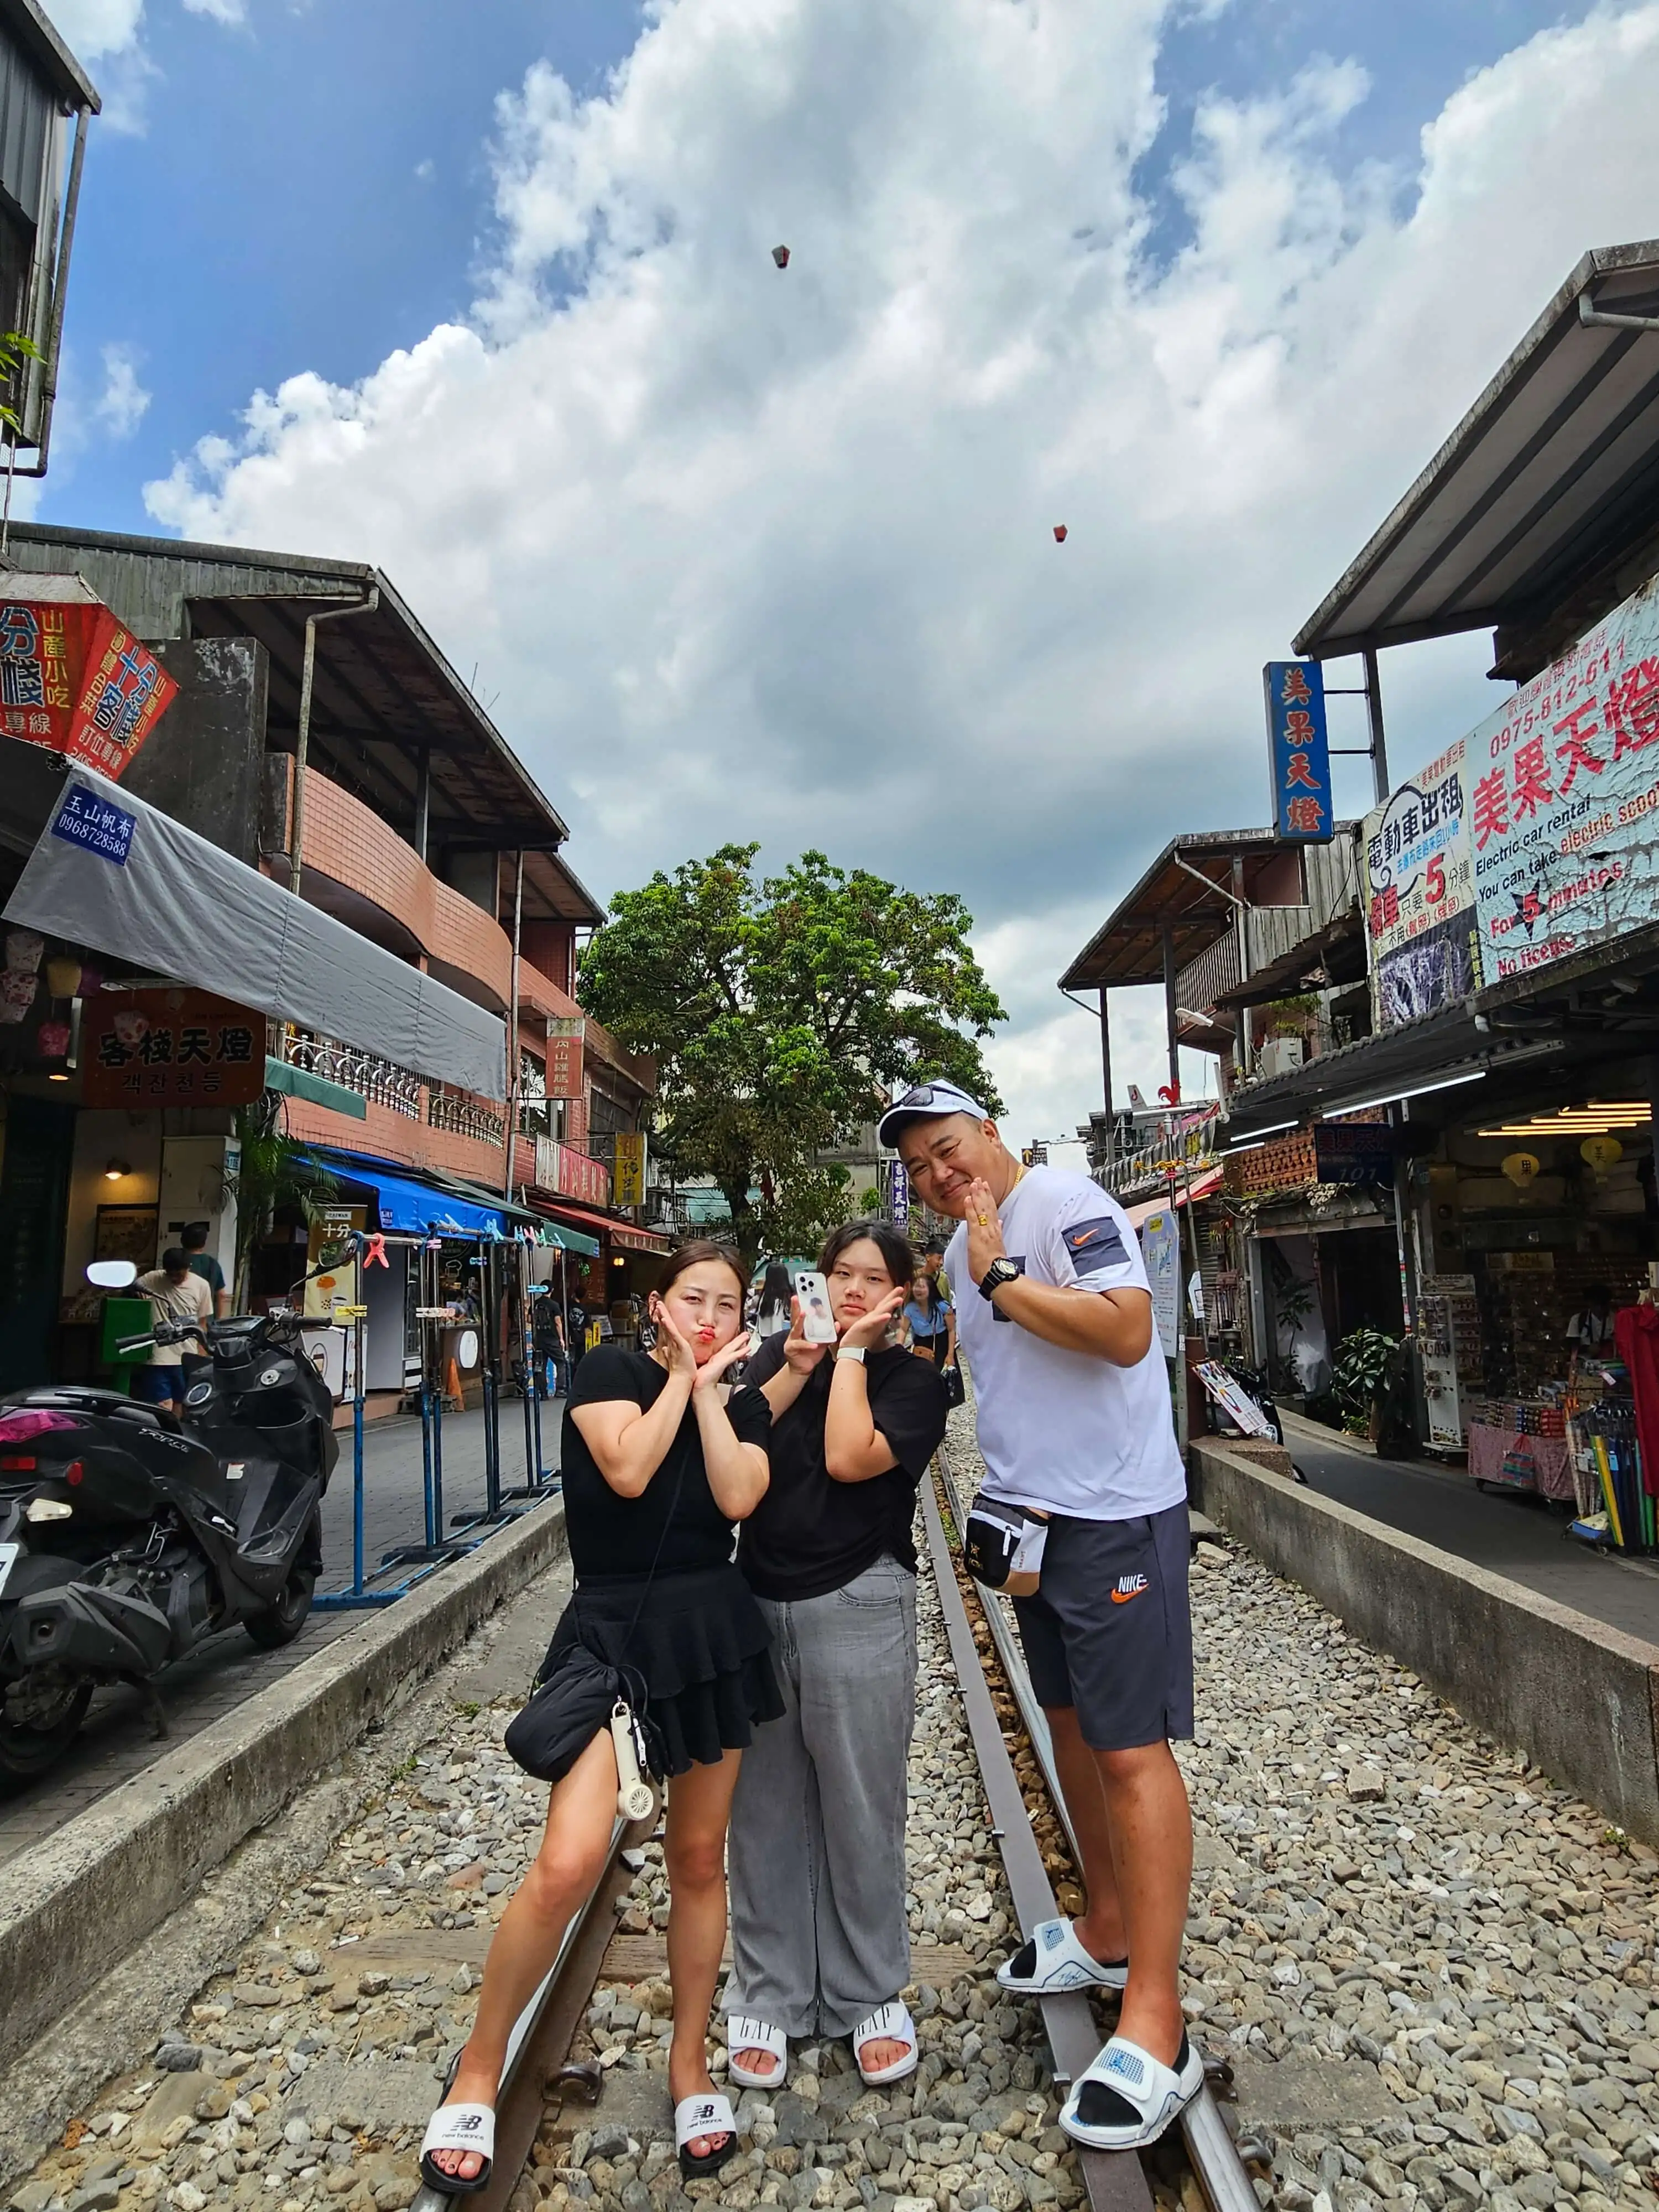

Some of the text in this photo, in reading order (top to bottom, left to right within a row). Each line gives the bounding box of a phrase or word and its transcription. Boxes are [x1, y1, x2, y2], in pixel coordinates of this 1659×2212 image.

[42, 609, 71, 708] 山產小吃
[0, 712, 52, 734] 專線
[1281, 667, 1324, 832] 美果天燈
[59, 813, 127, 857] 0968728588
[65, 795, 131, 840] 玉山帆布
[1368, 771, 1461, 870] 電動車出租
[1476, 792, 1590, 877] Electric car rental
[1425, 852, 1446, 905] 5
[1479, 885, 1499, 904] You
[1503, 868, 1525, 890] can
[1528, 850, 1557, 878] take
[1561, 813, 1613, 854] electric
[1490, 914, 1516, 939] For
[1522, 891, 1541, 923] 5
[1496, 956, 1517, 978] No
[97, 1025, 254, 1070] 客棧天燈
[1339, 1167, 1377, 1181] 101
[322, 1223, 351, 1239] 十分
[1118, 1574, 1147, 1593] NIKE
[457, 2132, 484, 2141] balance
